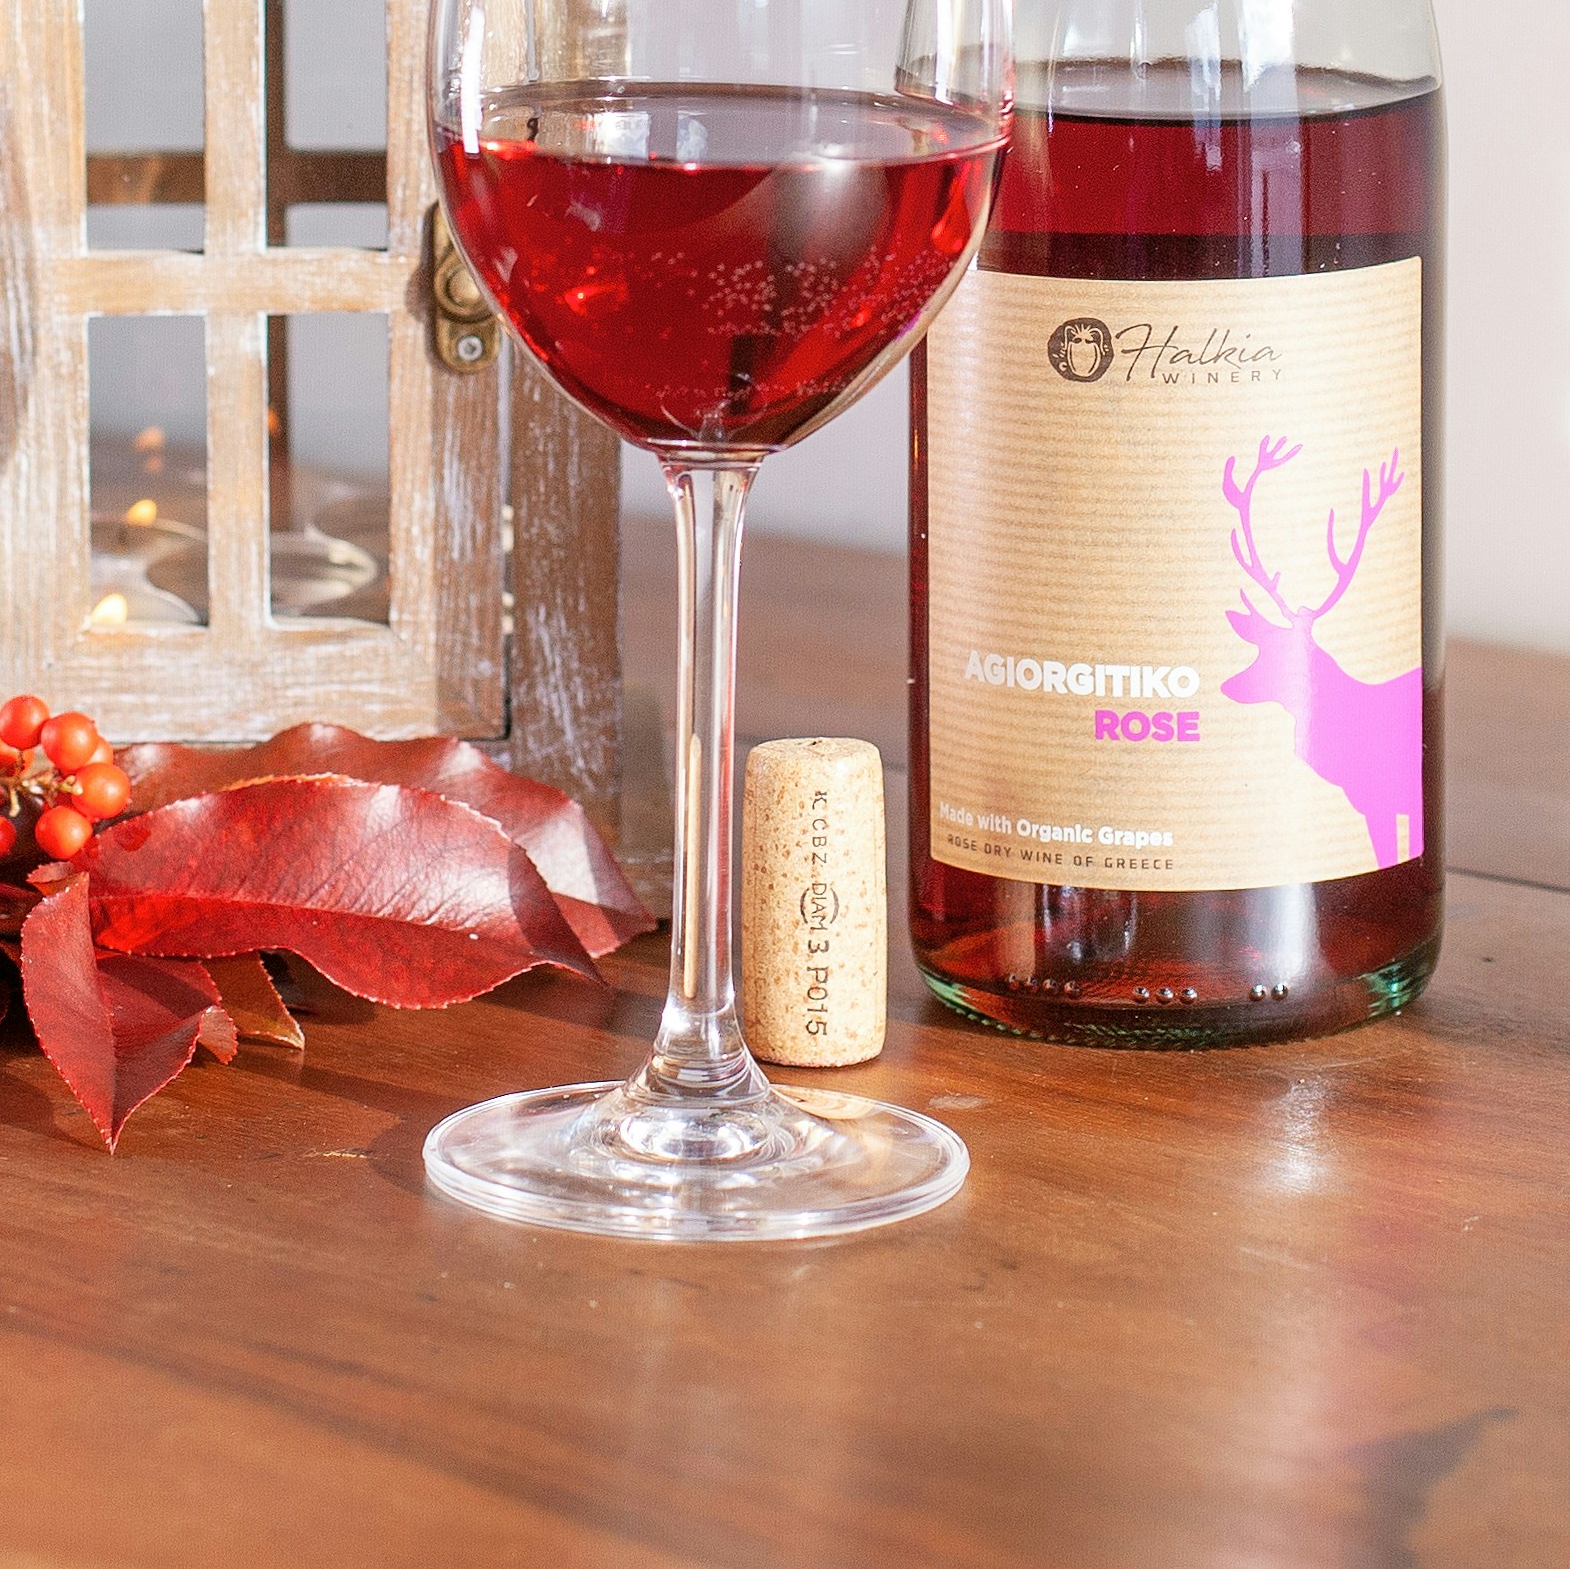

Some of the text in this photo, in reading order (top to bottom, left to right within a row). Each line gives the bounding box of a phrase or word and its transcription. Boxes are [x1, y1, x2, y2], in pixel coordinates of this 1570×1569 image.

[1115, 323, 1282, 381] Halkia
[1162, 369, 1282, 384] WINERY
[964, 650, 1200, 699] AGIORGITIKO
[1094, 709, 1200, 742] ROSE
[939, 801, 1174, 849] Made with Organic Grapes
[947, 834, 1174, 870] ROSE DRY WINE OF GREECE
[810, 883, 828, 930] DIAM
